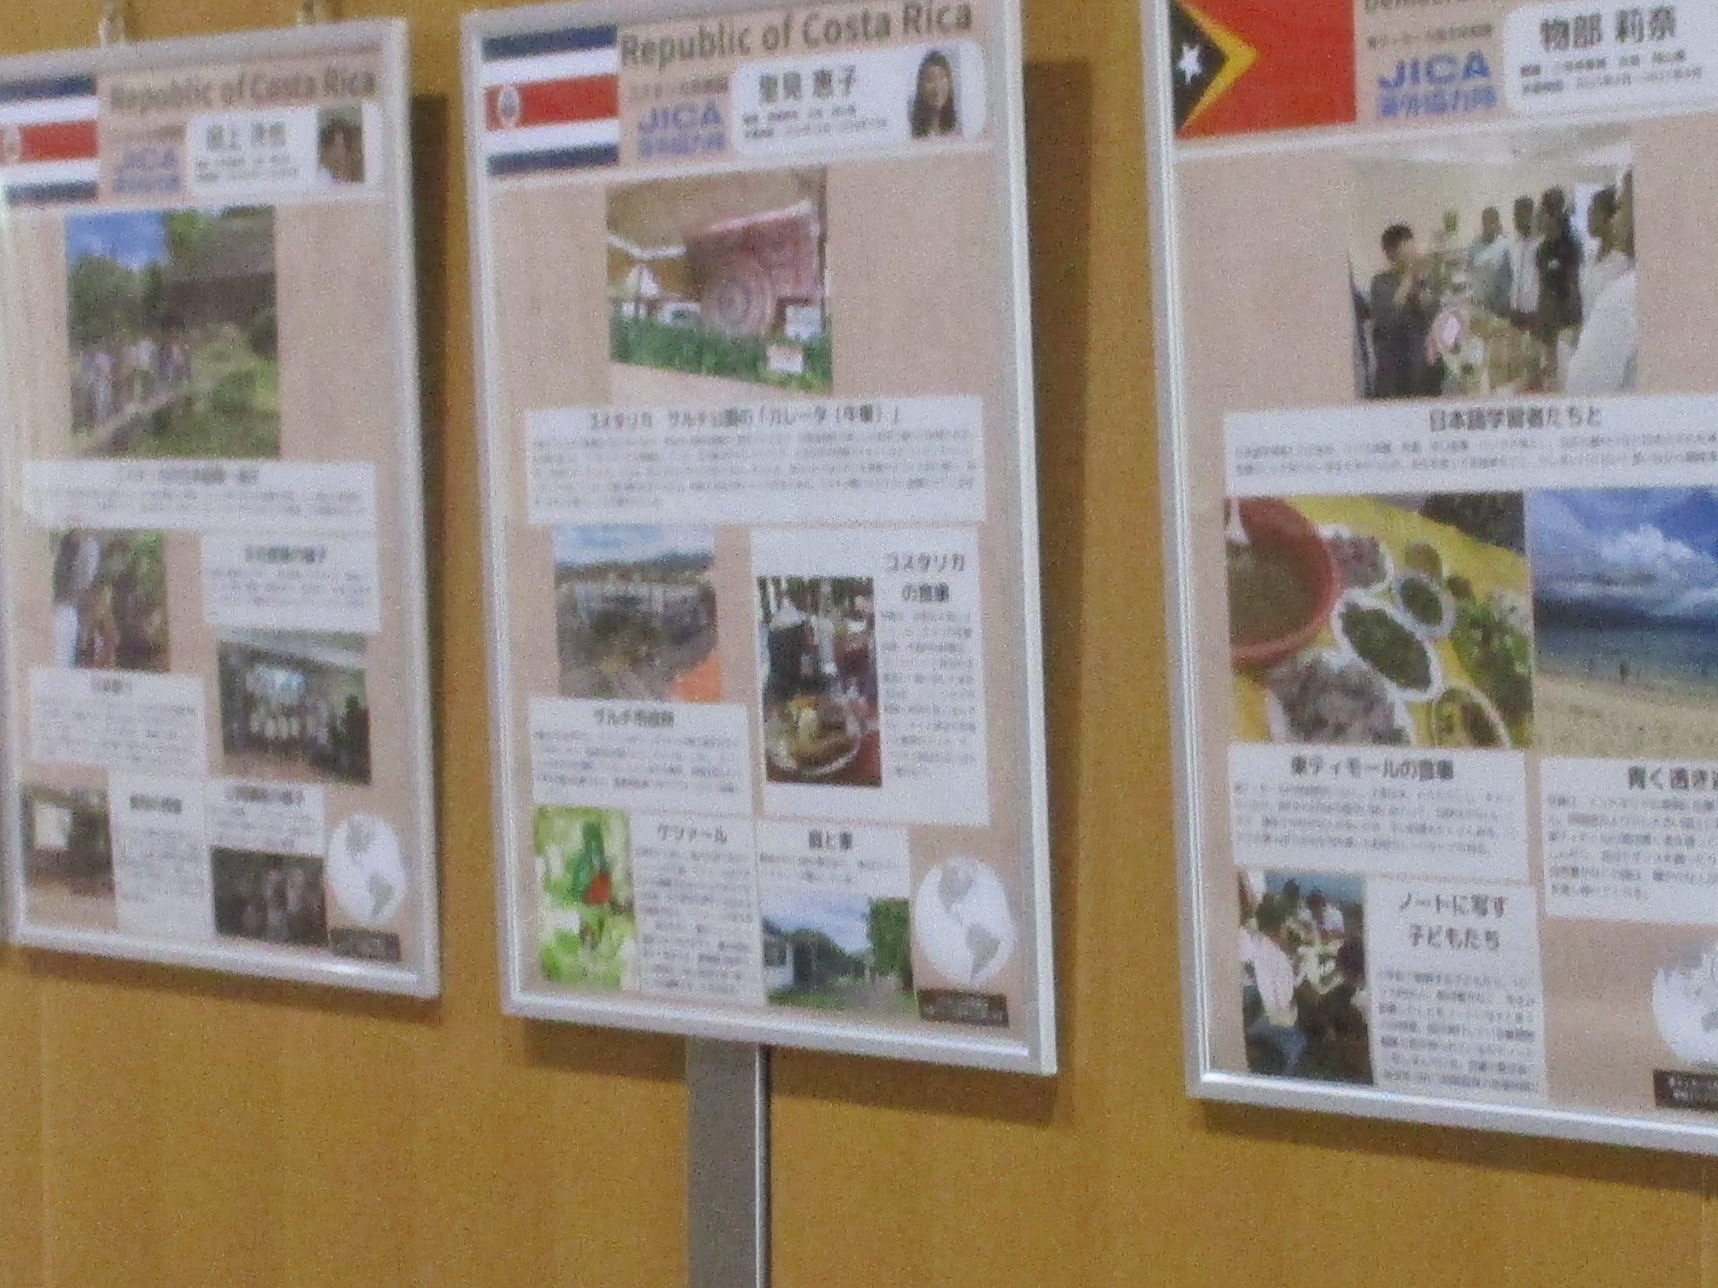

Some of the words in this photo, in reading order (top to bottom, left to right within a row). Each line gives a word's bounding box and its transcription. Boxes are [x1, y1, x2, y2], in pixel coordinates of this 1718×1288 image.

[621, 20, 751, 70] Republic
[762, 13, 794, 51] of
[803, 8, 891, 49] Costa
[1379, 50, 1491, 89] JICA
[1409, 923, 1500, 951] 子どもたち
